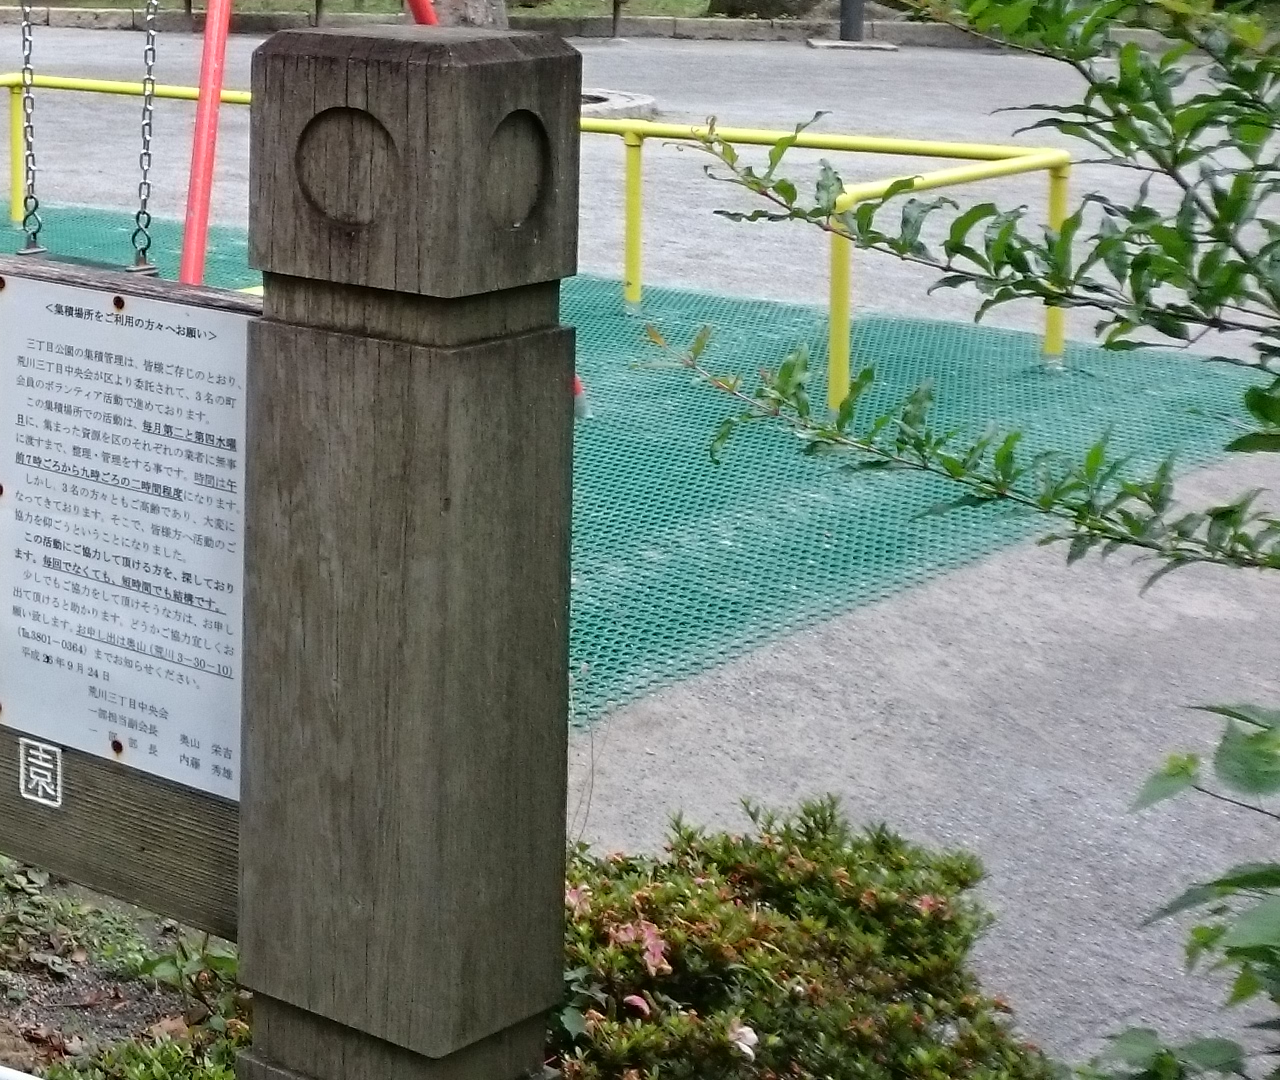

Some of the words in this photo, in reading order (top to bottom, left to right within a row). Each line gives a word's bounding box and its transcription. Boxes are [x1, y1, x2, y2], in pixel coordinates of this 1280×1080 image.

[88, 684, 168, 720] 荒川三丁目中央会
